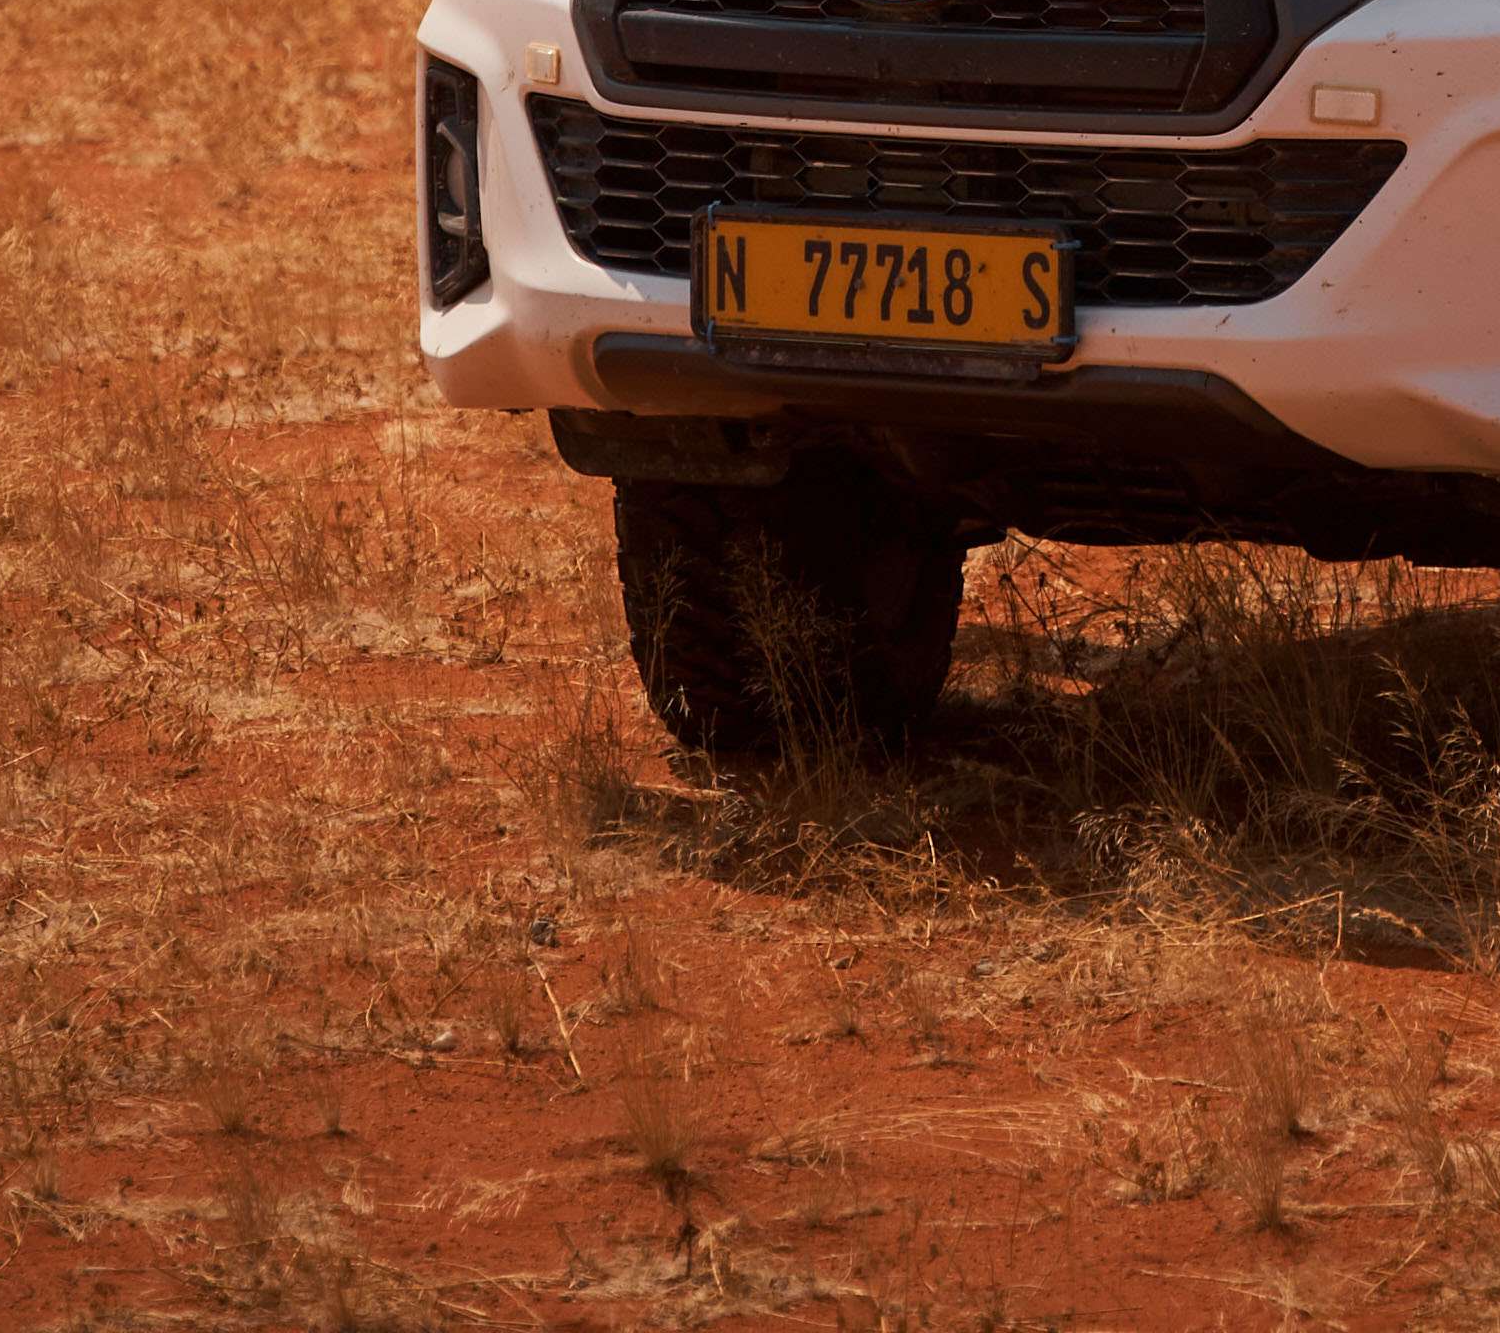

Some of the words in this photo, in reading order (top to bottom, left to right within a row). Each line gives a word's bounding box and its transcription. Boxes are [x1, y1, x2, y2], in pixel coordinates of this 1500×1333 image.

[717, 236, 746, 312] N
[805, 240, 973, 326] 77718
[1022, 252, 1050, 329] S
